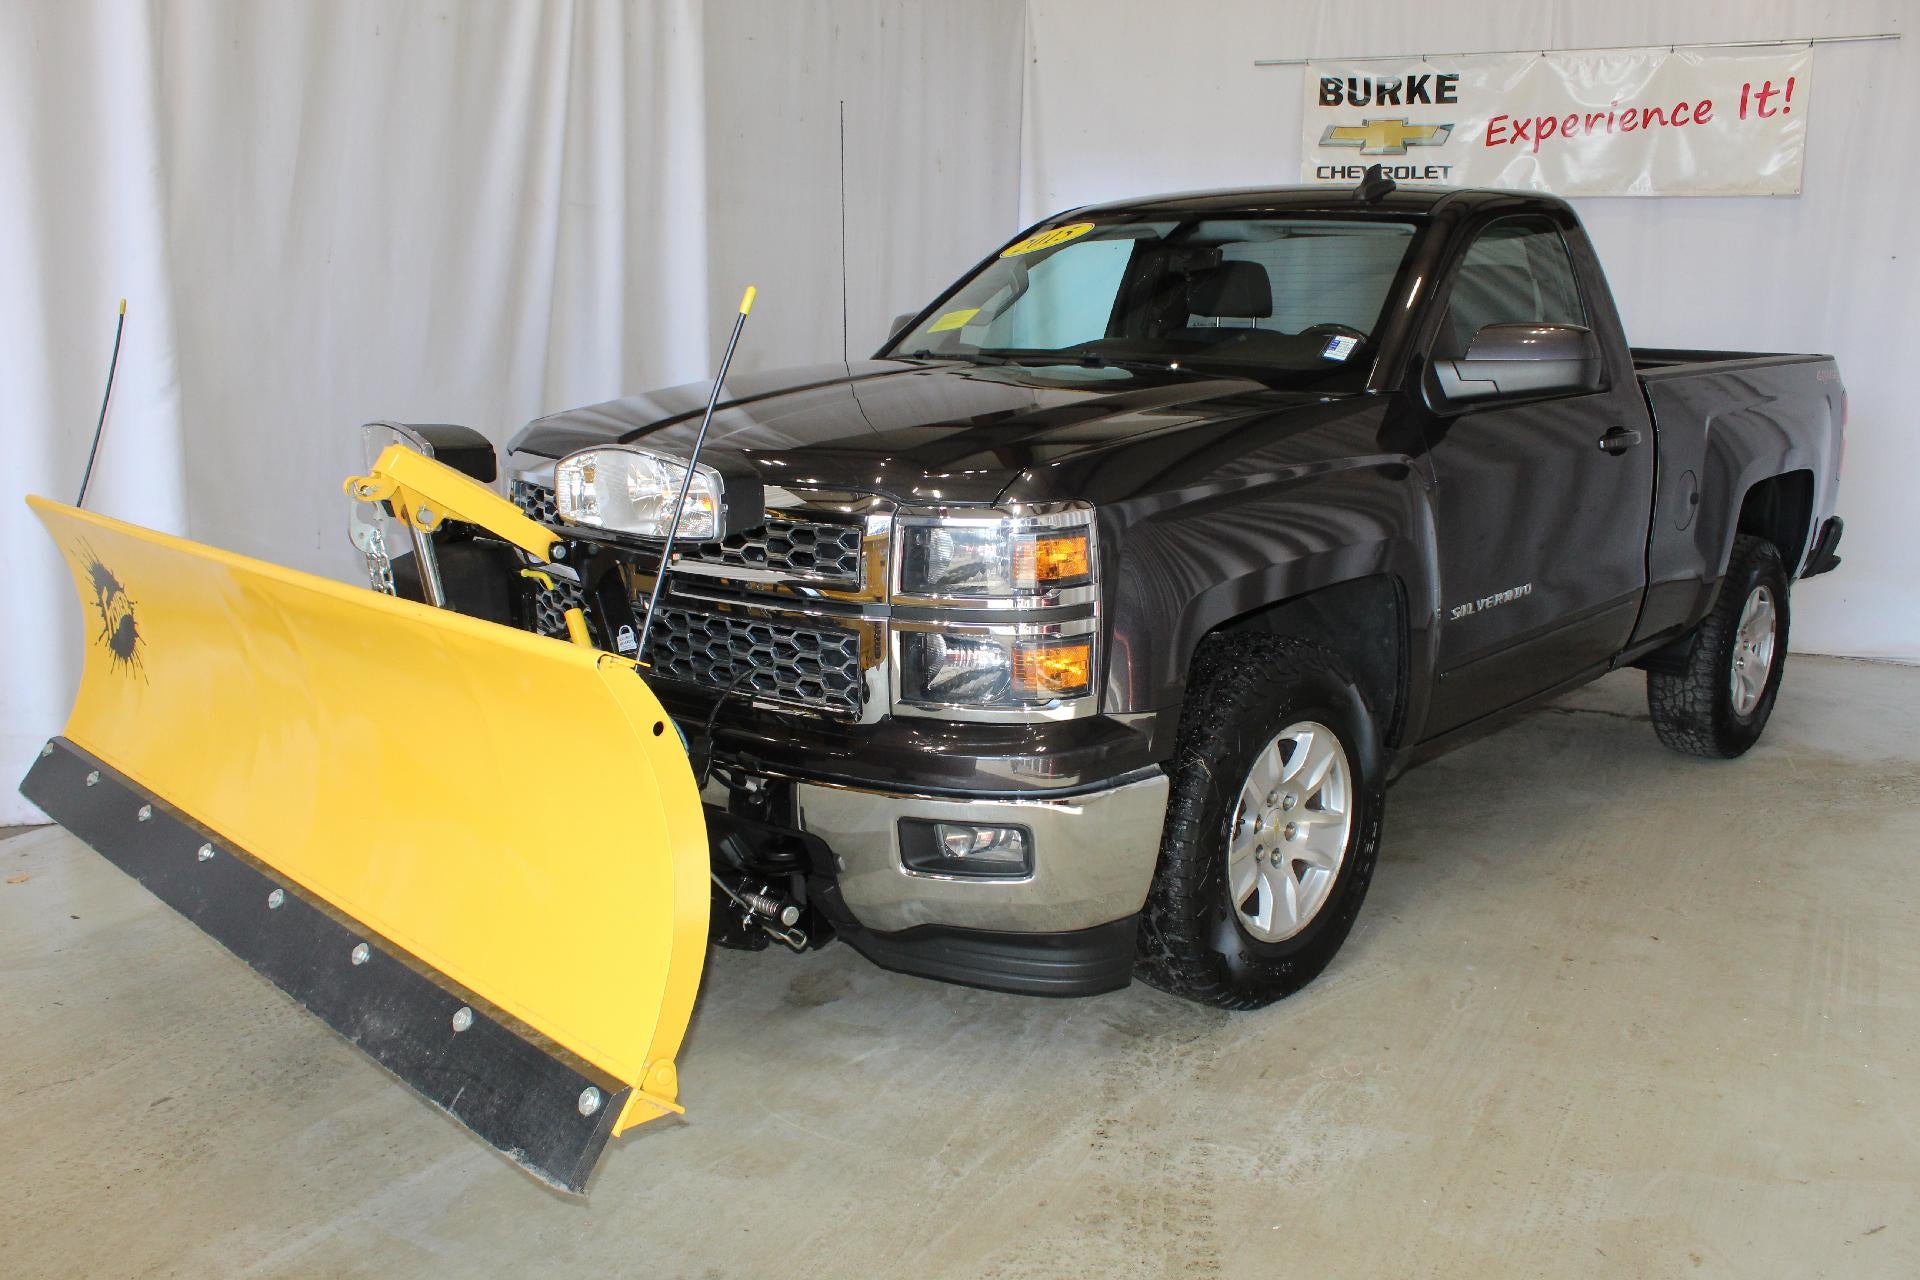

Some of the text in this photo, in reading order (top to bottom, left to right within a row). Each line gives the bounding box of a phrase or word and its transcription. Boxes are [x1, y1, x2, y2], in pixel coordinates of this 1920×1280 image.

[1319, 73, 1460, 107] BURKE
[1485, 77, 1796, 153] Experience It!
